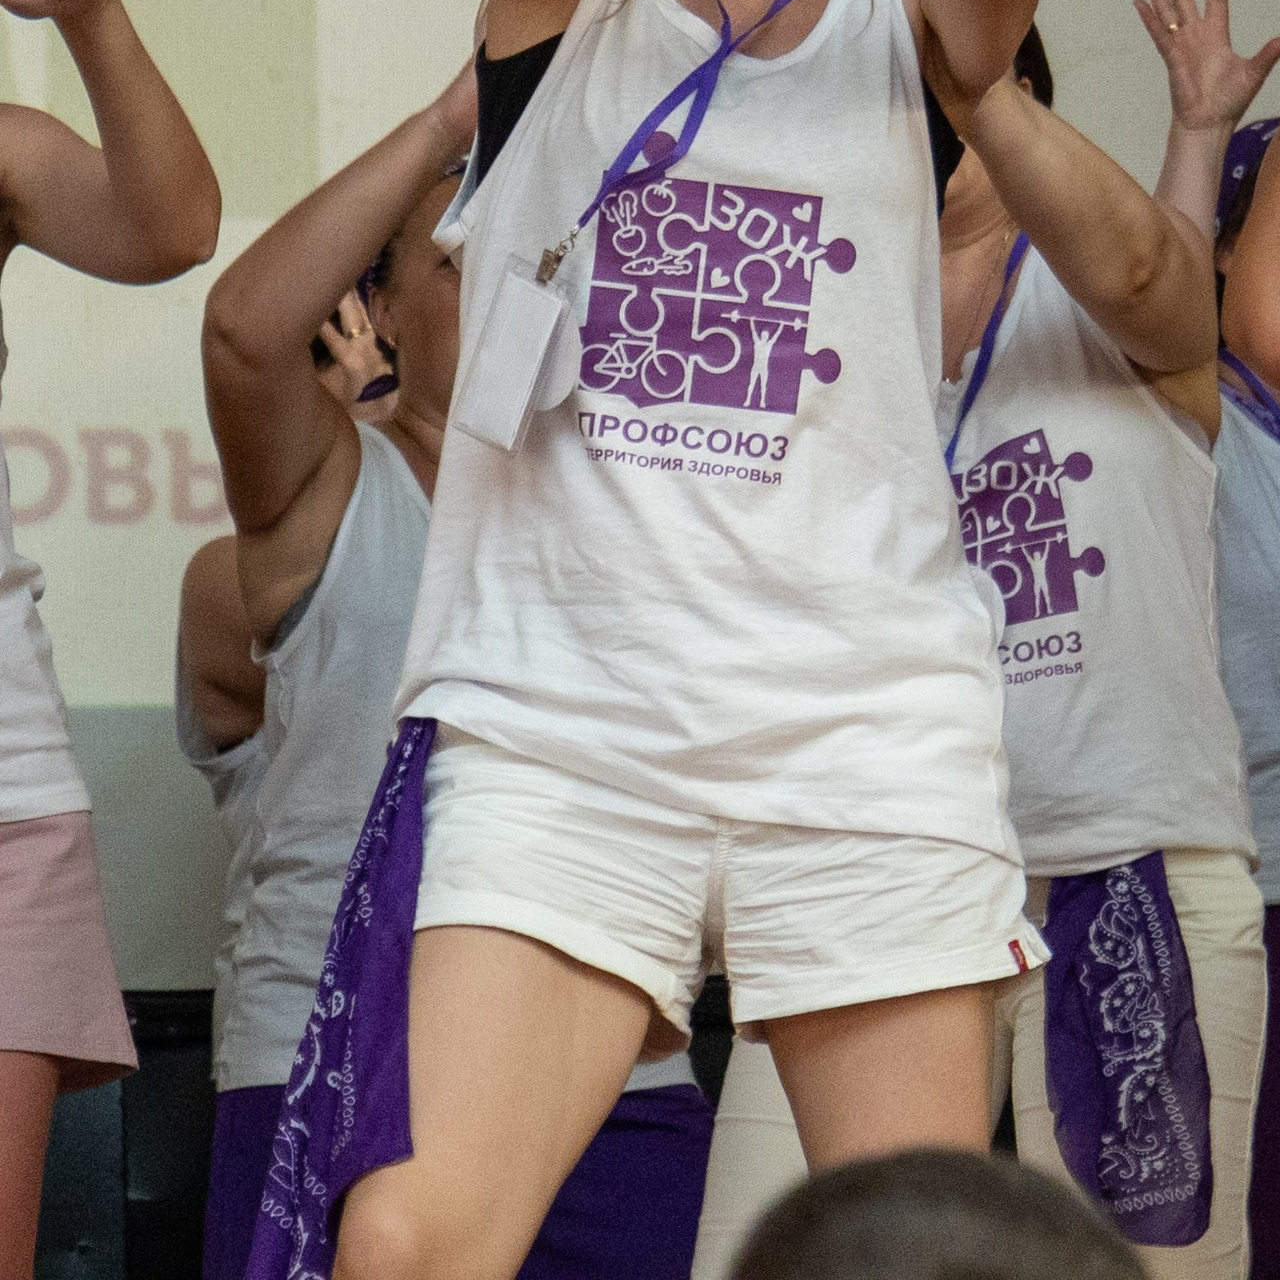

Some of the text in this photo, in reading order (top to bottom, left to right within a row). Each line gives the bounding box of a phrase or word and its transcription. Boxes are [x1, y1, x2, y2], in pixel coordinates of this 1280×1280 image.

[710, 190, 827, 281] ЗОЖ
[578, 412, 789, 461] ПРОФСОЮЗ
[585, 447, 782, 485] ТЕРРИТОРИЯ ЗДОРОВЬЯ
[966, 461, 1064, 498] ЗОЖ
[1005, 662, 1083, 685] ЗДОРОВЬЯ
